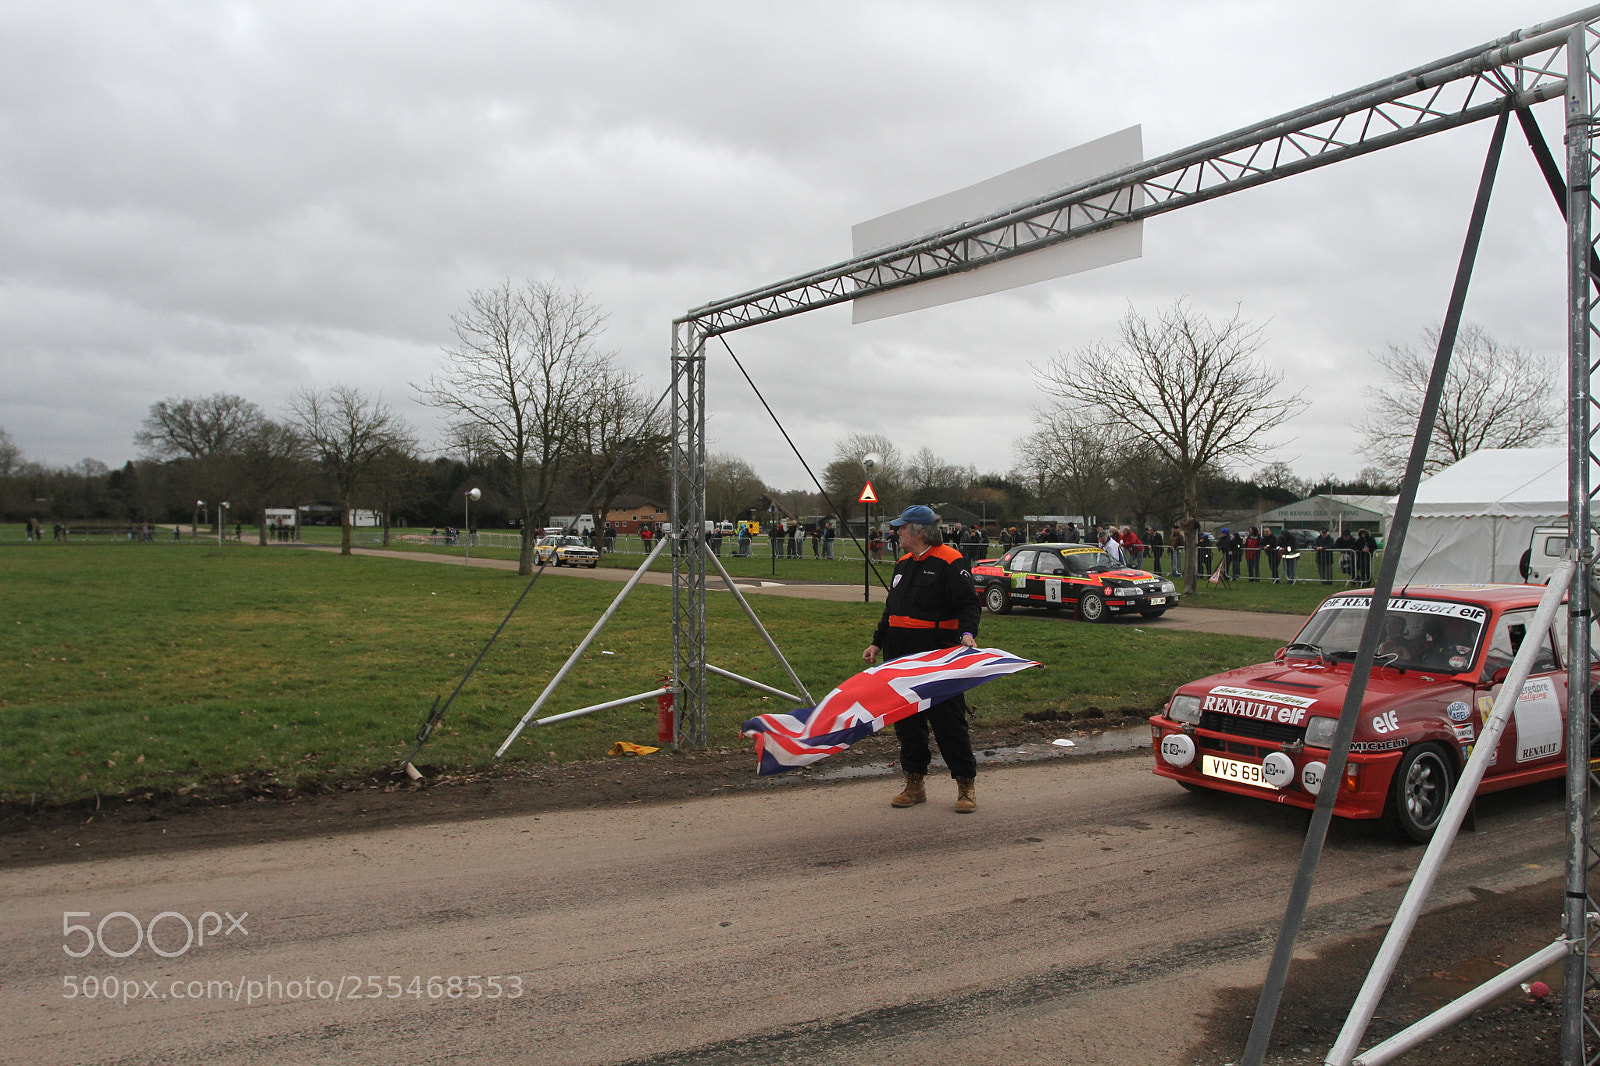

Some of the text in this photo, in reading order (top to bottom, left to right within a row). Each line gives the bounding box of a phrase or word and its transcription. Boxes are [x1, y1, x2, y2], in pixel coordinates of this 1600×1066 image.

[1050, 587, 1056, 600] 3
[1323, 598, 1341, 609] elf
[1410, 601, 1456, 614] sport
[1459, 607, 1485, 620] elf
[1202, 695, 1307, 725] RENAULT elf
[1372, 710, 1400, 734] elf
[1349, 737, 1409, 752] MICHELIN
[1522, 743, 1558, 759] RENAULT
[1213, 759, 1238, 777] VVS
